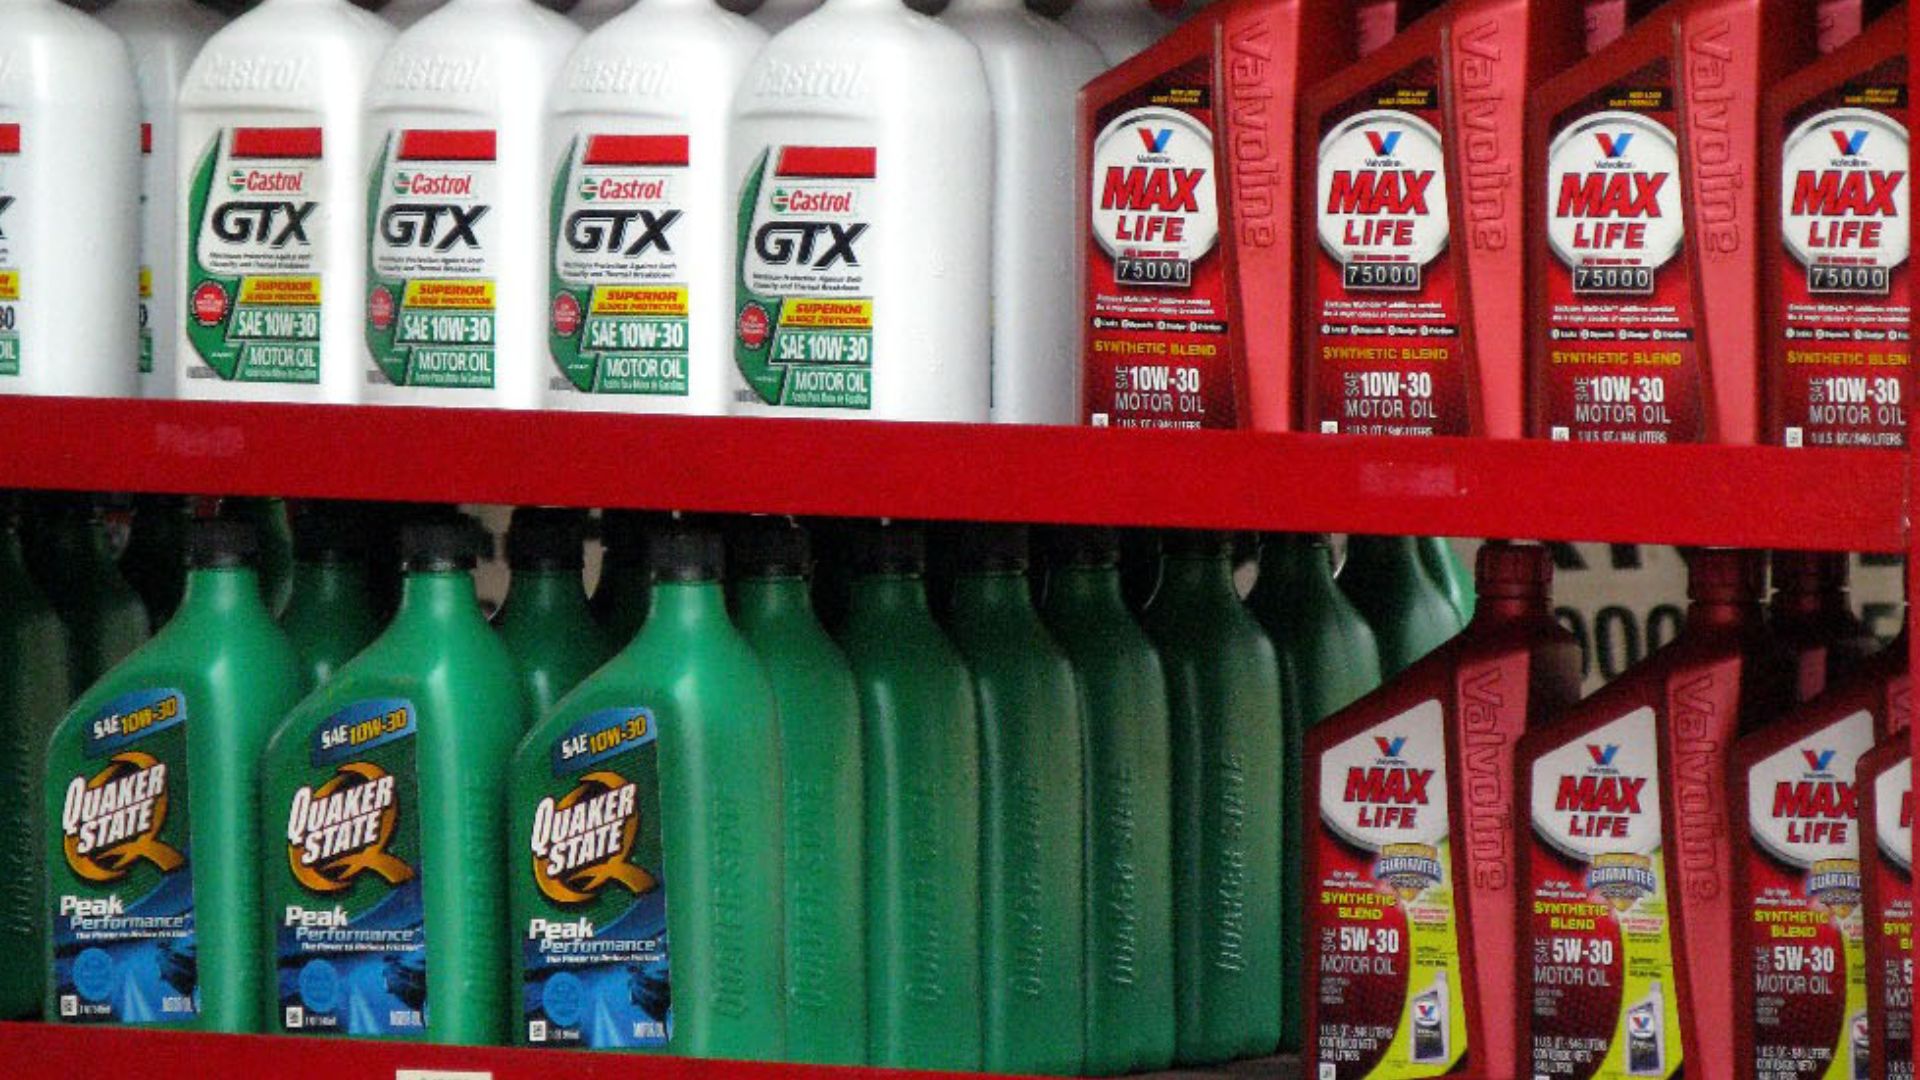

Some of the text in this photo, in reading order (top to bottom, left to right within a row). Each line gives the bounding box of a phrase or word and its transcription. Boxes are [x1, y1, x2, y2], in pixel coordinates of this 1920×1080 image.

[1229, 19, 1279, 248] Valvoline
[1460, 19, 1510, 251] Valvoline
[1690, 19, 1743, 254] Valvoline
[247, 171, 303, 191] Castrol
[411, 174, 471, 195] Castrol
[600, 178, 663, 199] Castrol
[1100, 166, 1206, 212] MAX
[1327, 170, 1436, 215] MAX
[1791, 170, 1905, 216] MAX
[789, 190, 852, 212] Castrol
[1556, 172, 1670, 218] MAX
[211, 201, 319, 249] GTX
[380, 203, 491, 253] GTX
[564, 209, 685, 259] GTX
[1116, 214, 1186, 242] LIFE
[1343, 219, 1415, 245] LIFE
[1573, 222, 1648, 249] LIFE
[1808, 221, 1883, 248] LIFE
[755, 221, 870, 271] GTX
[1121, 262, 1185, 279] 75000
[1347, 266, 1417, 283] 75000
[1579, 269, 1649, 287] 75000
[1812, 268, 1884, 287] 75000
[239, 311, 317, 337] SAE 10W-30
[404, 315, 491, 341] SAE 10W-30
[592, 322, 683, 348] SAE 10W-30
[251, 348, 316, 367] MOTOR OIL
[780, 333, 867, 361] SAE 10W-30
[1094, 341, 1217, 356] SYNTHETIC BLEND
[1323, 346, 1448, 360] SYNTHETIC BLEND
[1552, 351, 1682, 365] SYNTHETIC BLEND
[1787, 350, 1911, 366] SYNTHETIC BLEN
[420, 352, 491, 371] MOTOR OIL
[606, 359, 685, 378] MOTOR OIL
[794, 371, 867, 392] MOTOR OIL
[1129, 367, 1200, 392] 10W-30
[1361, 372, 1432, 397] 10W-30
[1590, 376, 1665, 403] 10W-30
[1825, 377, 1900, 404] 10W-30
[1115, 393, 1205, 412] MOTOR OIL
[1345, 400, 1437, 418] MOTOR OIL
[1575, 405, 1672, 424] MOTOR OIL
[1809, 405, 1906, 425] MOTOR OIL
[93, 696, 178, 740] SAE 10W-30
[321, 707, 408, 750] SAE 10W-30
[561, 715, 648, 759] SAE 10W-30
[1343, 766, 1435, 805] MAX
[1462, 663, 1512, 891] Valvoline
[1674, 673, 1729, 899] Valvoline
[62, 763, 167, 836] QUAKER
[1554, 775, 1648, 814] MAX
[1772, 782, 1859, 819] MAX
[288, 775, 394, 845] QUAKER
[531, 783, 636, 858] QUAKER
[1357, 806, 1418, 829] LIFE
[77, 798, 155, 853] STATE
[301, 809, 382, 864] STATE
[1568, 815, 1630, 838] LIFE
[1787, 821, 1848, 844] LIFE
[546, 819, 625, 876] STATE
[60, 894, 124, 916] Peak
[1321, 891, 1396, 906] SYNTHETIC
[1535, 901, 1609, 917] SYNTHETIC
[70, 914, 184, 930] Performance
[285, 904, 348, 926] Peak
[1339, 906, 1383, 920] BLEND
[1550, 917, 1596, 930] BLEND
[1754, 909, 1830, 924] SYNTHETIC
[296, 926, 415, 942] Performance
[529, 916, 594, 939] Peak
[1340, 926, 1400, 954] 5W-30
[1771, 926, 1817, 938] BLEND
[540, 938, 656, 954] Performance
[1552, 938, 1613, 966] 5W-30
[1321, 955, 1397, 975] MOTOR OIL
[1774, 945, 1835, 973] 5W-30
[1535, 965, 1611, 987] MOTOR OIL
[1755, 975, 1834, 995] MOTOR OIL
[1885, 988, 1914, 1007] MOT
